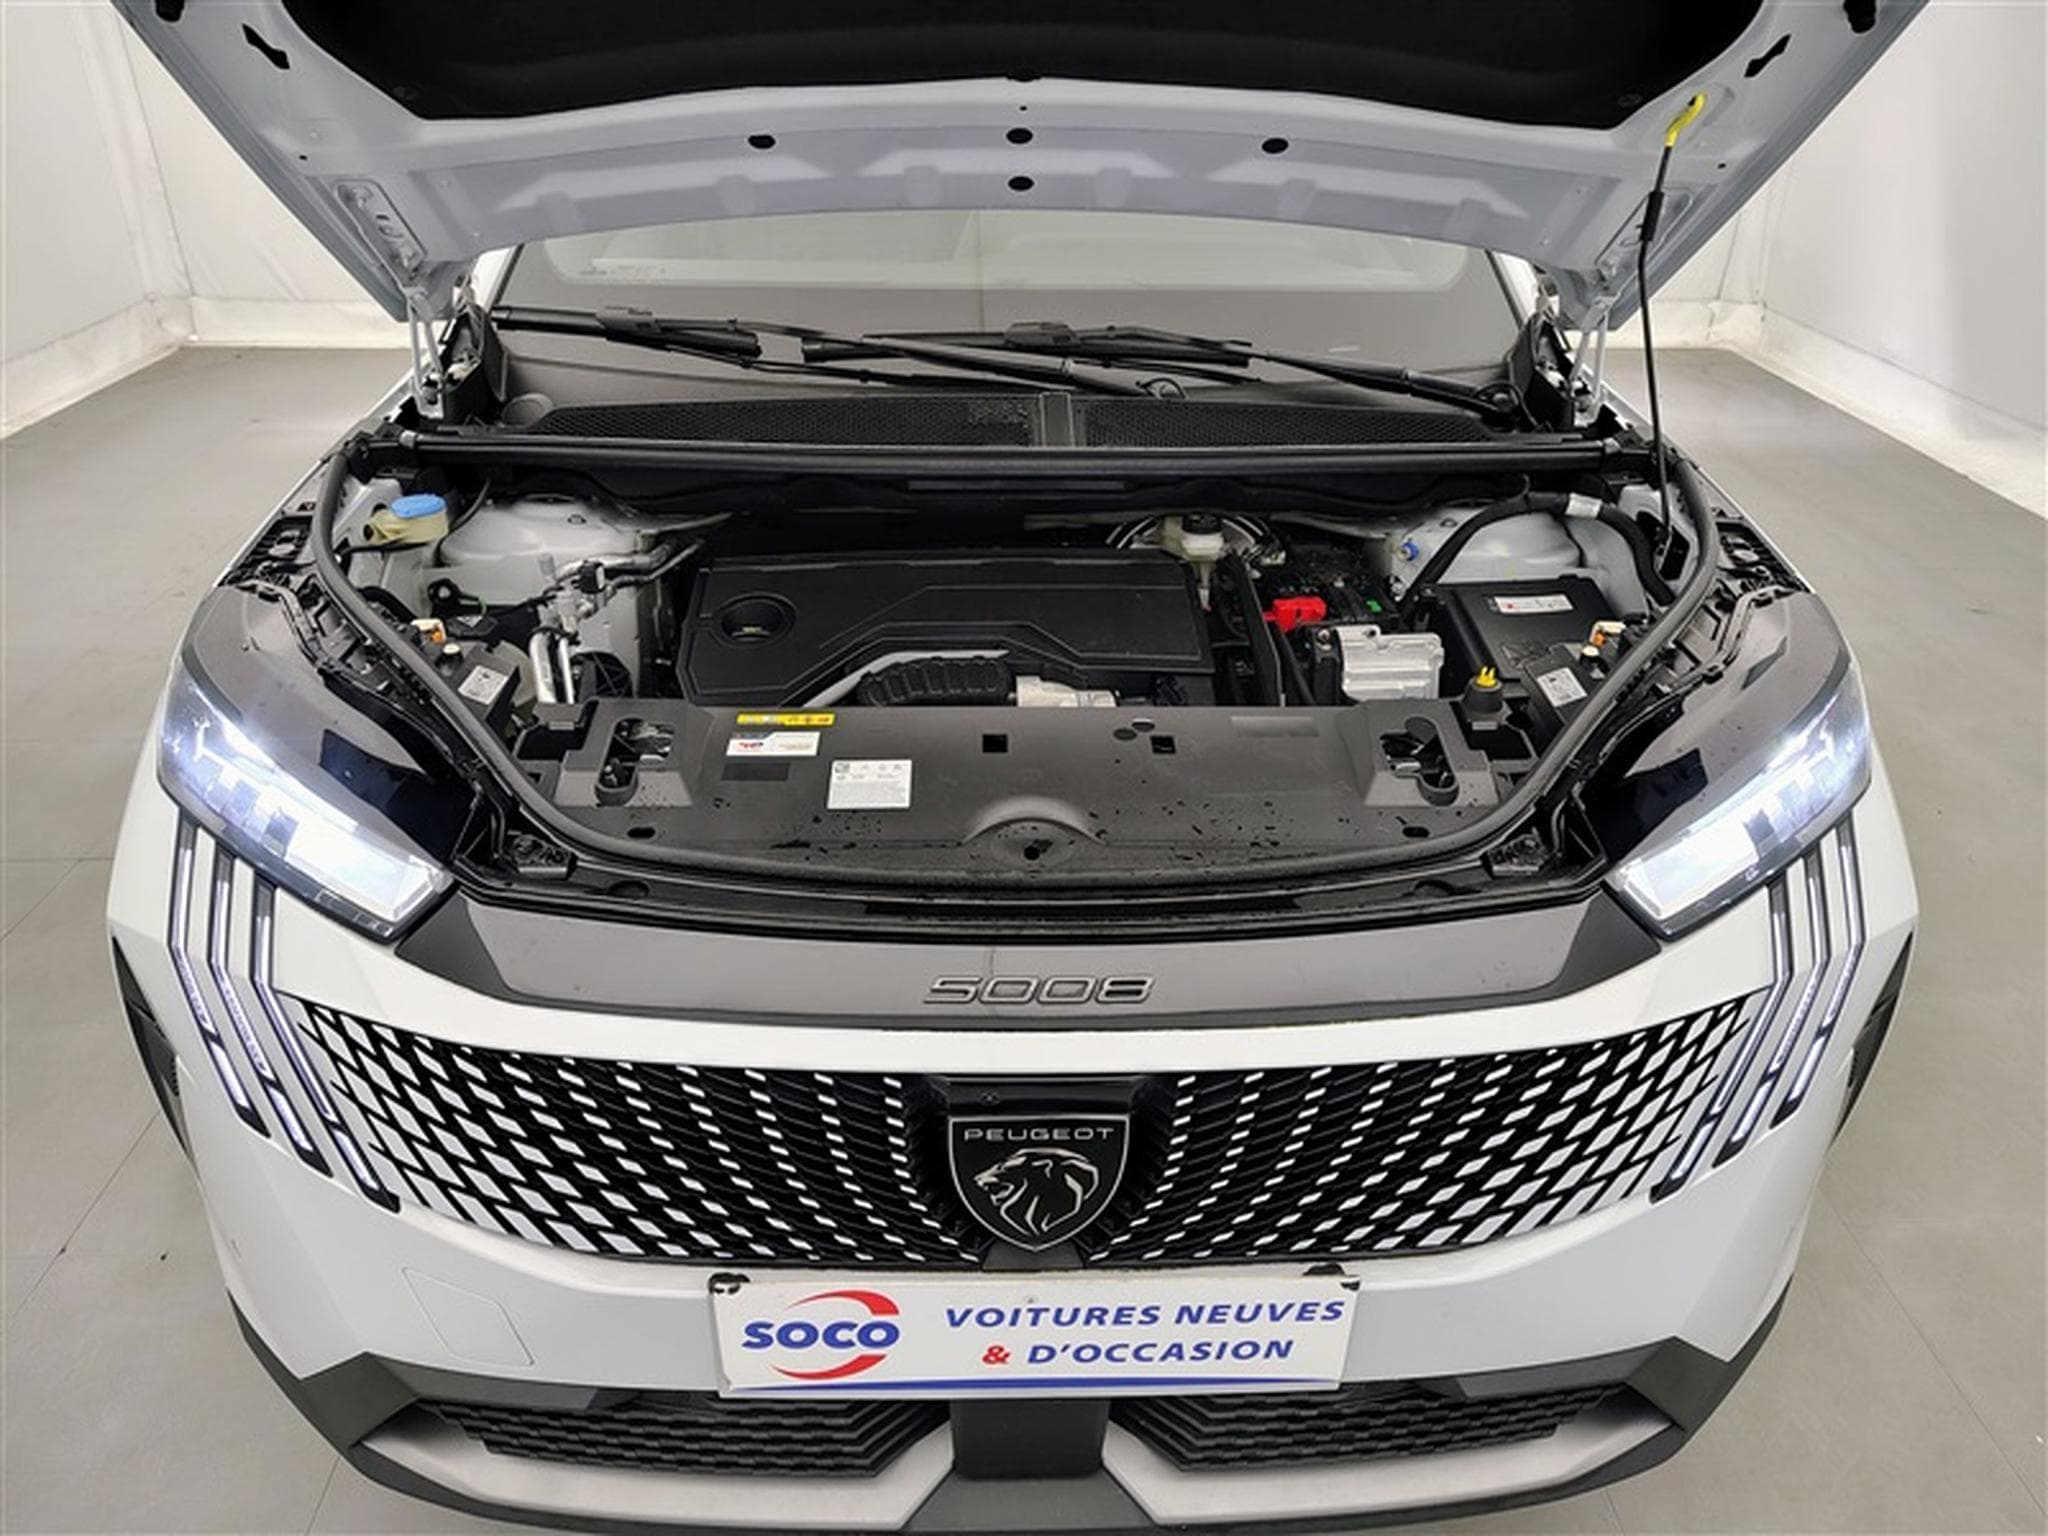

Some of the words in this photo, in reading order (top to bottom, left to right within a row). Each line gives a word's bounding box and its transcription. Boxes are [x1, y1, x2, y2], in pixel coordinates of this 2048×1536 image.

[923, 975, 1154, 1004] 5008
[963, 1127, 1114, 1142] PEUGEOT
[946, 1306, 1161, 1328] VOITURES
[1174, 1301, 1345, 1325] NEUVES
[741, 1320, 900, 1349] SOCO
[982, 1345, 1011, 1365] &
[1027, 1339, 1294, 1364] D'OCCASION
